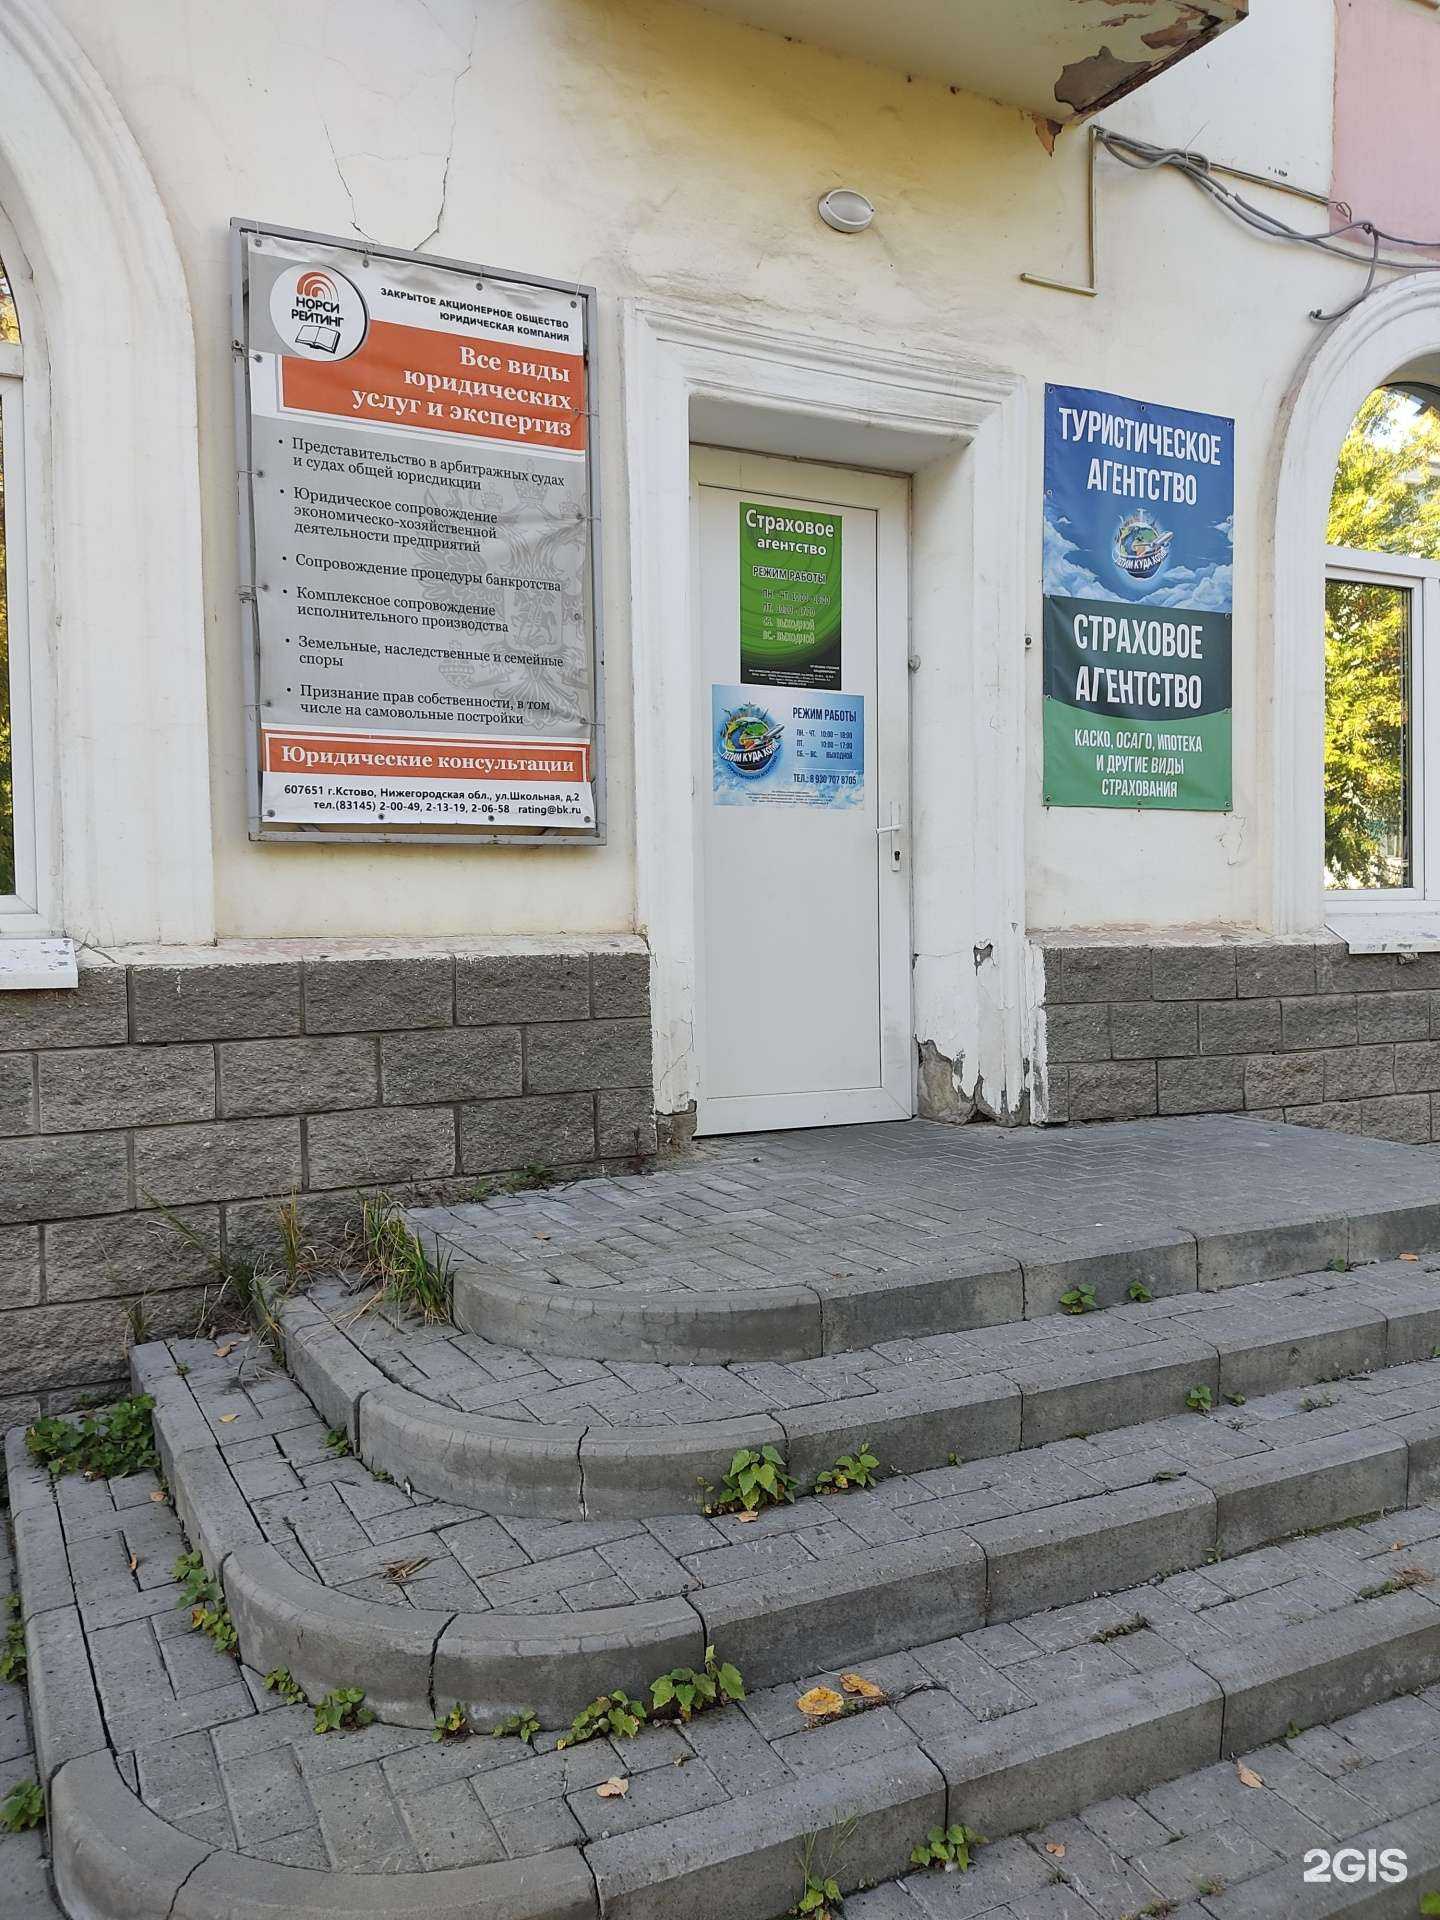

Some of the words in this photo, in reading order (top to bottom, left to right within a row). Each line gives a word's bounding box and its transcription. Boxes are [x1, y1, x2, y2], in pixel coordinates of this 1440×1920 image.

[291, 309, 344, 328] РЕЙТИНГ
[296, 297, 340, 314] НОРСИ
[380, 287, 437, 305] ЗАКРЫТОЕ
[439, 299, 513, 319] АКЦИОНЕРНОЕ
[515, 311, 569, 328] ОБЩЕСТВО
[439, 312, 515, 333] ЮРИДИЧЕСКАЯ
[517, 325, 569, 342] КОМПАНИЯ
[459, 346, 501, 371] Все
[507, 359, 569, 383] виды
[404, 368, 572, 410] юридических
[352, 387, 420, 416] услуг
[428, 400, 442, 417] и
[450, 403, 572, 437] экспертиз
[1058, 406, 1222, 466] ТУРИСТИЧЕСКОЕ
[292, 437, 426, 468] Представительство
[430, 459, 437, 469] в
[440, 459, 529, 482] арбитражных
[531, 471, 565, 488] судах
[293, 456, 303, 467] и
[306, 457, 345, 475] судах
[348, 462, 393, 482] общей
[397, 469, 481, 491] юрисдикции
[1086, 457, 1197, 506] АГЕНТСТВО
[293, 486, 392, 510] Юридическое
[395, 501, 498, 524] сопровождение
[294, 506, 497, 540] экономическо-хозяйственной
[294, 521, 389, 543] деятельности
[393, 532, 481, 553] предприятий
[745, 509, 834, 538] Страховое
[757, 537, 827, 556] агентство
[295, 553, 407, 577] Сопровождение
[411, 567, 482, 587] процедуры
[485, 573, 562, 592] банкротства
[753, 566, 789, 580] РЕЖИМ
[790, 570, 827, 585] РАБОТЫ
[296, 586, 390, 608] Комплексное
[394, 597, 496, 617] сопровождение
[297, 604, 418, 626] исполнительного
[422, 615, 509, 633] производства
[1073, 613, 1203, 660] СТРАХОВОЕ
[298, 635, 381, 655] Земельные,
[384, 643, 490, 662] наследственные
[493, 653, 501, 663] и
[504, 653, 563, 668] семейные
[299, 653, 344, 669] споры
[300, 685, 380, 701] Признание
[383, 691, 414, 705] прав
[417, 691, 514, 711] собственности,
[517, 700, 524, 709] в
[527, 700, 550, 711] том
[1075, 665, 1202, 710] АГЕНТСТВО
[300, 702, 342, 715] числе
[345, 705, 362, 716] на
[365, 706, 454, 721] самовольные
[457, 712, 524, 726] постройки
[792, 706, 823, 720] РЕЖИМ
[824, 709, 857, 722] РАБОТЫ
[1074, 729, 1114, 749] КАСКО,
[1116, 731, 1155, 751] ОСАГО,
[1157, 733, 1203, 753] ИПОТЕКА
[281, 745, 433, 768] Юридические
[437, 756, 575, 774] консультации
[742, 750, 763, 762] КУДА
[1096, 754, 1104, 771] И
[1106, 755, 1149, 774] ДРУГИЕ
[1151, 757, 1184, 776] ВИДЫ
[810, 773, 814, 783] 8
[815, 774, 828, 784] 930
[828, 774, 840, 785] 707
[840, 775, 857, 785] 8705
[1102, 778, 1178, 798] СТРАХОВАНИЯ
[284, 784, 324, 796] 607651
[327, 786, 377, 798] г.Кстово,
[380, 788, 465, 802] Нижегородская
[468, 791, 492, 801] обл.,
[495, 791, 562, 805] ул.Школьная,
[565, 793, 580, 804] д.2
[314, 799, 376, 812] тел.(83145)
[379, 800, 422, 813] 2-00-49,
[426, 802, 469, 814] 2-13-19,
[471, 803, 510, 814] 2-06-58
[517, 804, 582, 816] rating@bk.ru
